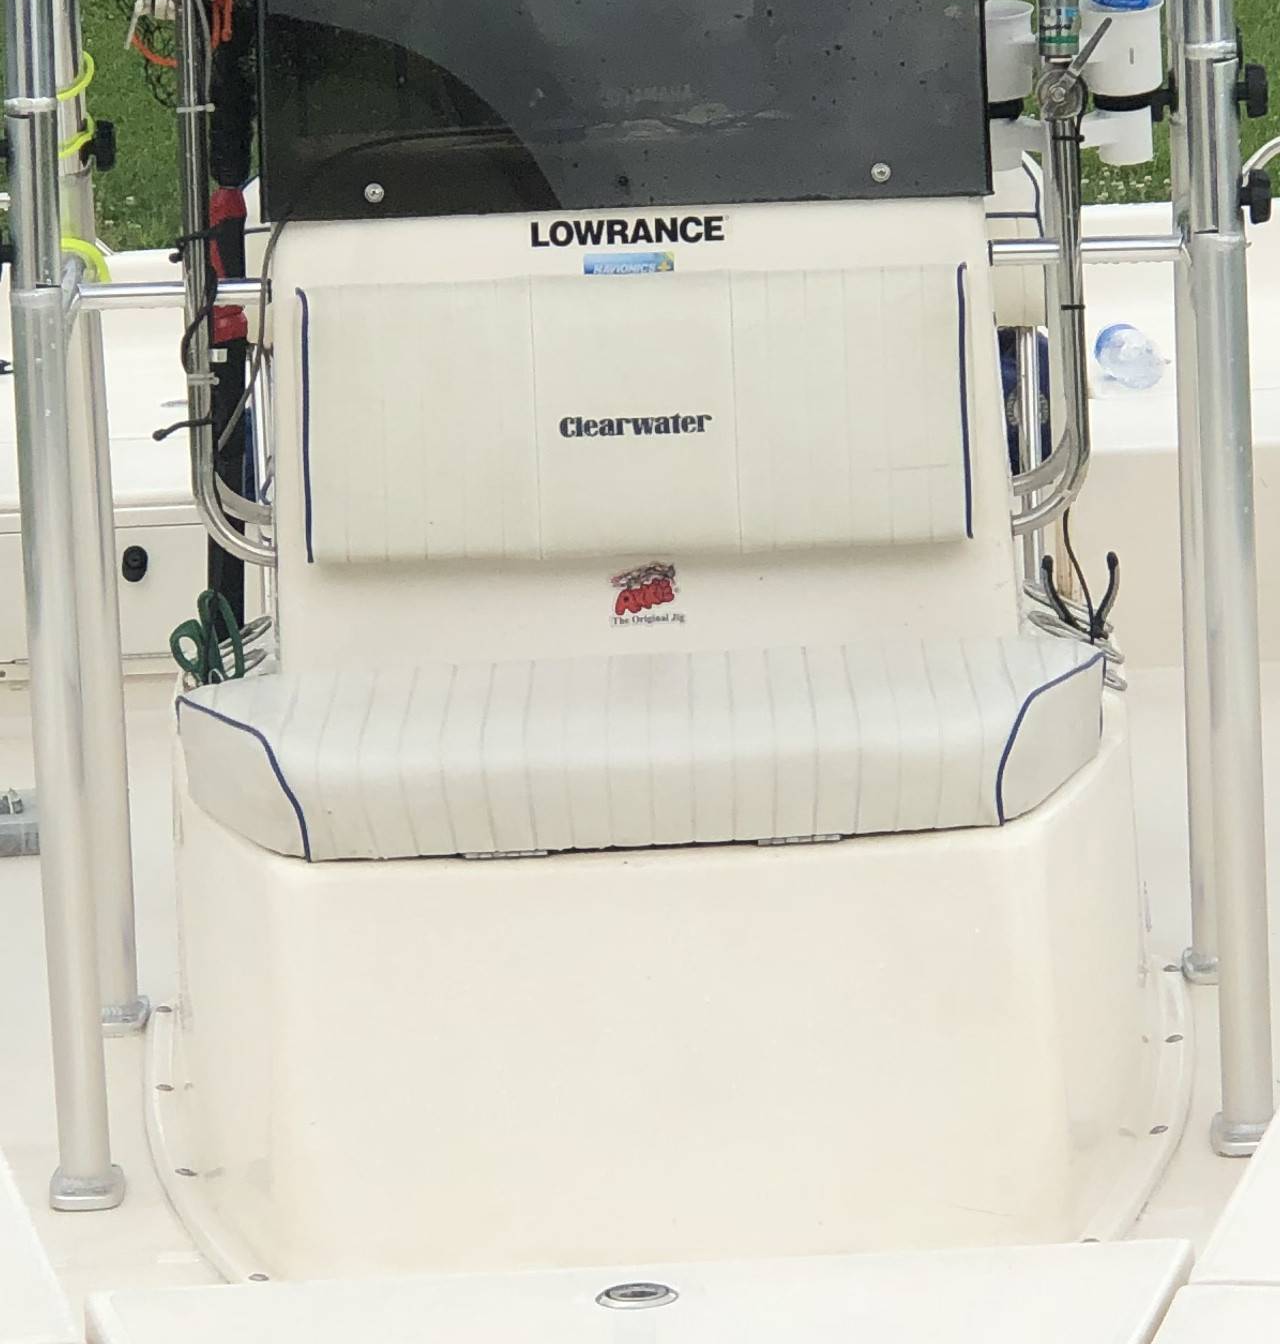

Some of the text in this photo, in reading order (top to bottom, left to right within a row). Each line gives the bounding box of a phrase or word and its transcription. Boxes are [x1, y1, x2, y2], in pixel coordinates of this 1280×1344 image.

[531, 216, 724, 247] LOWRANCE
[559, 412, 713, 438] Clearwater
[612, 616, 630, 625] The
[631, 613, 669, 624] Original
